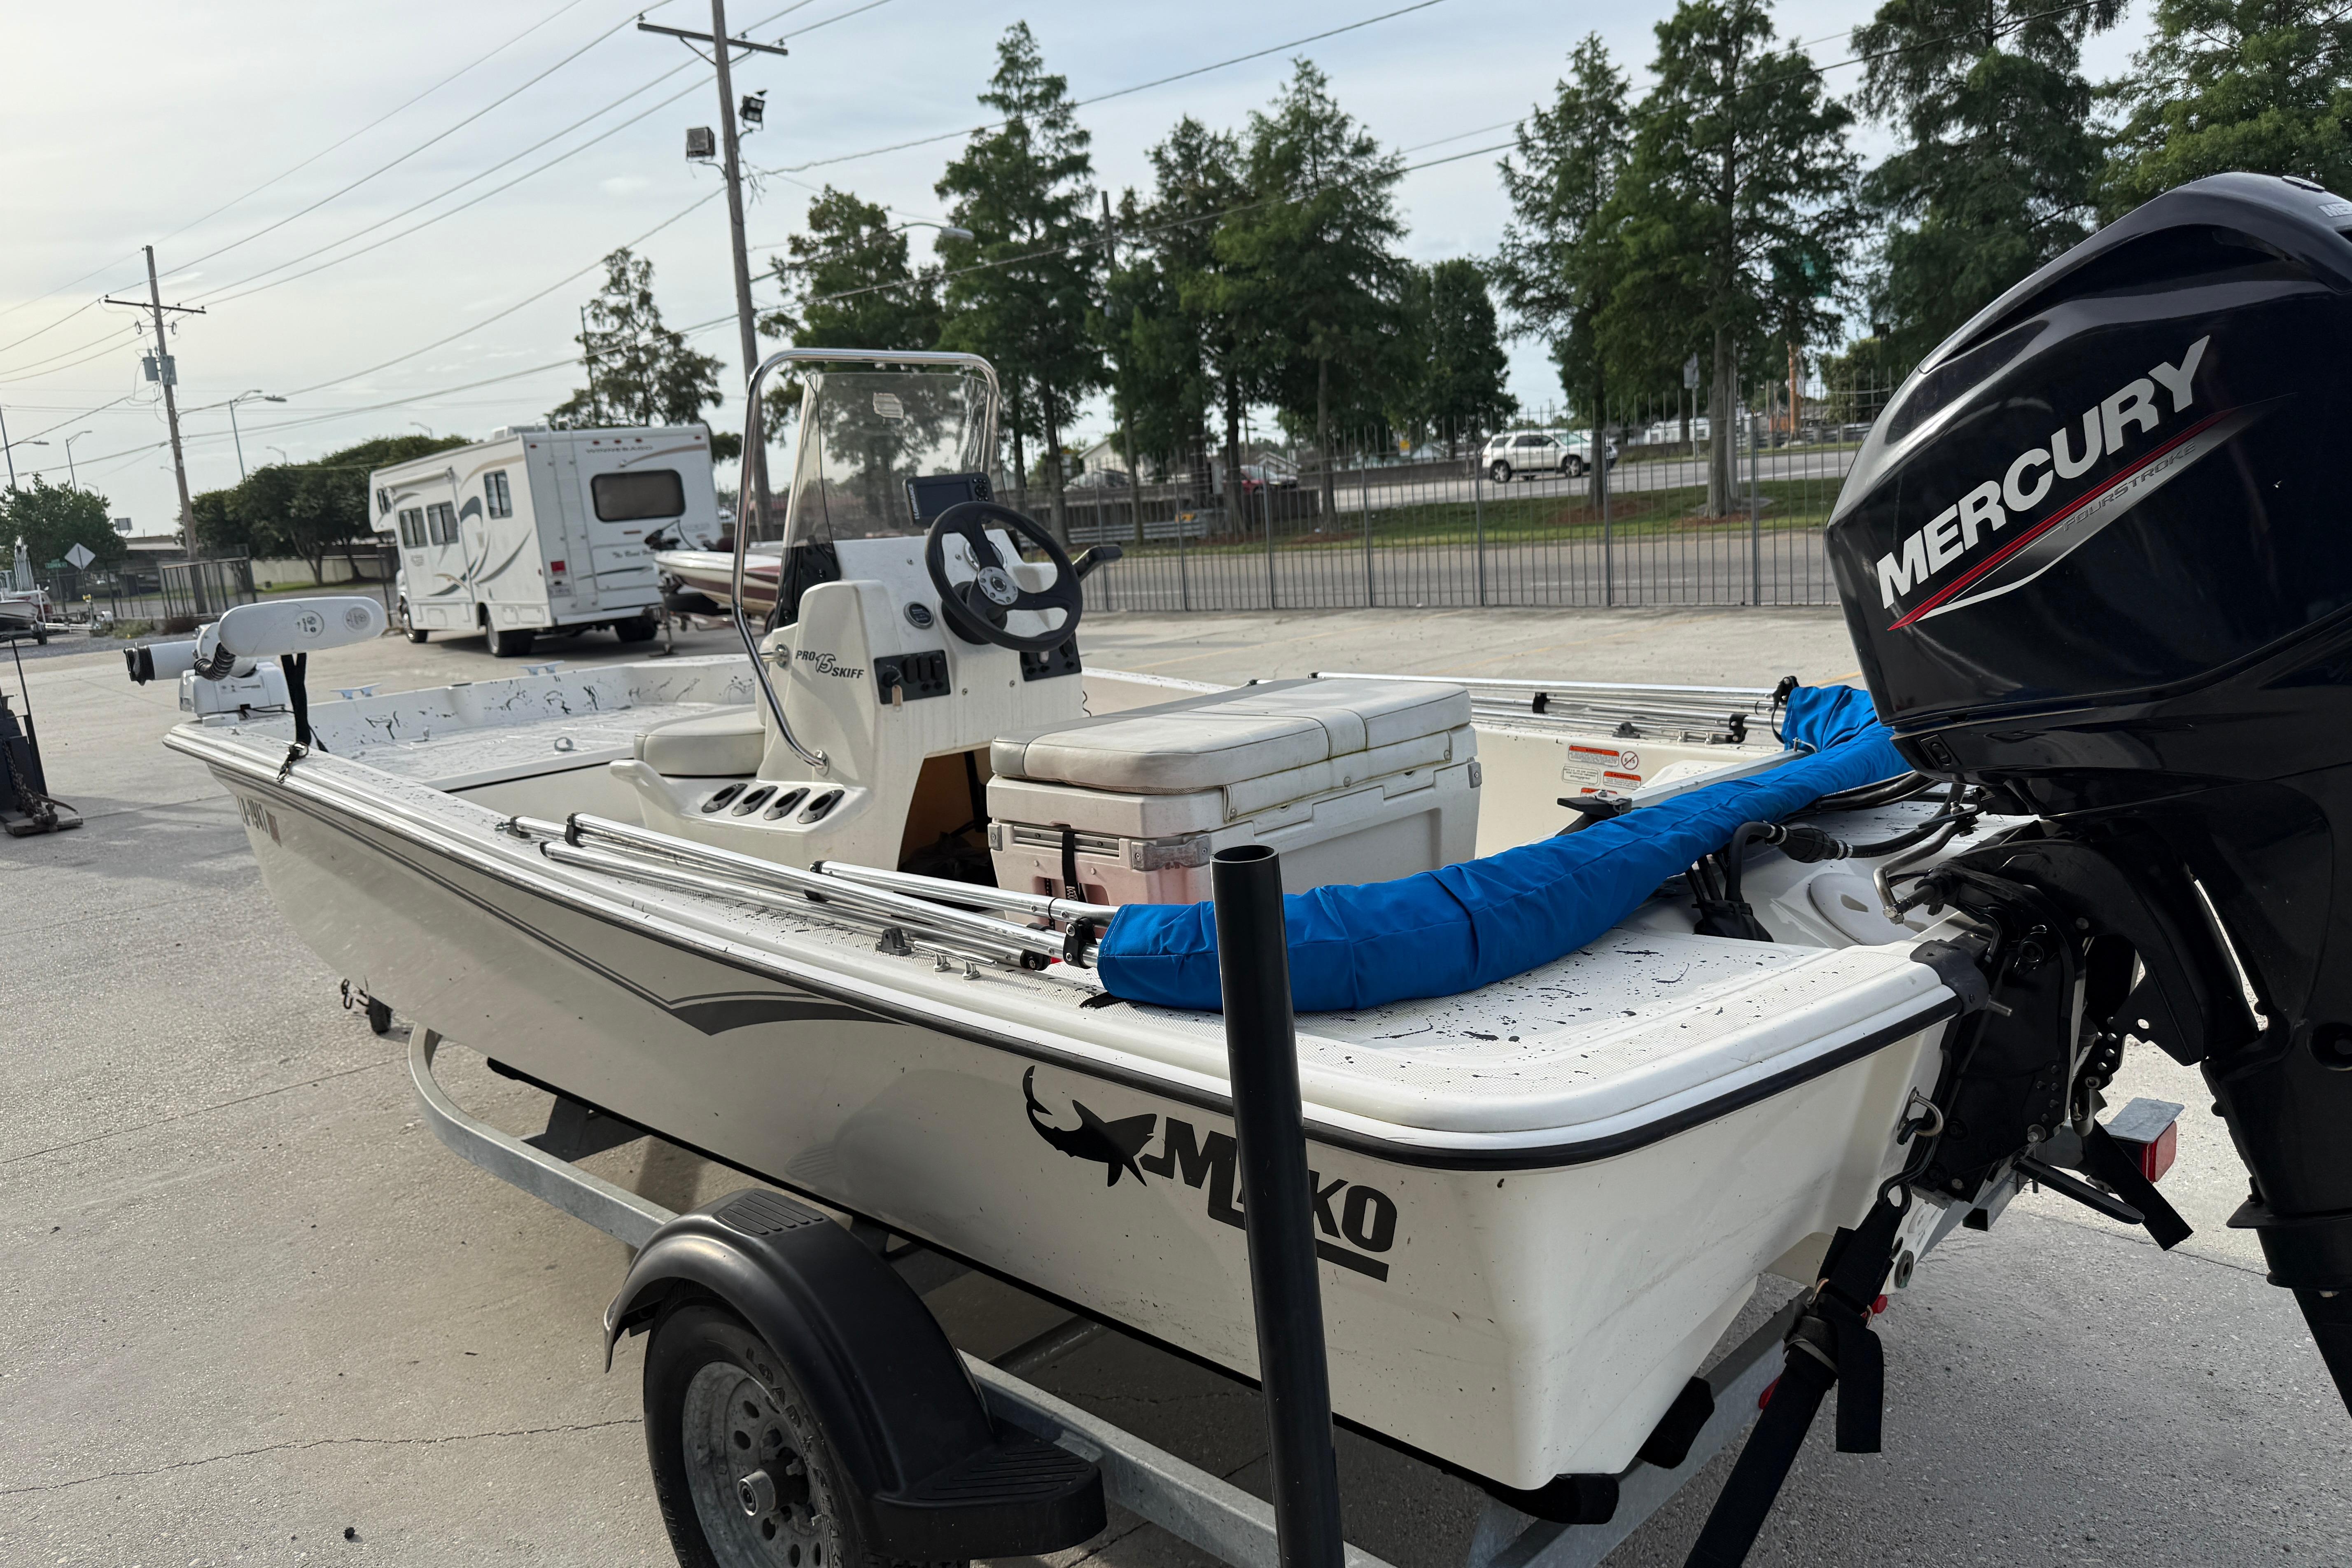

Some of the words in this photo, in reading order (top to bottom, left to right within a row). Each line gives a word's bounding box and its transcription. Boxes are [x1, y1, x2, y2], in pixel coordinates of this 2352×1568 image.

[586, 445, 653, 453] WINNEBAGO
[1876, 334, 2211, 609] MERCURY
[2062, 442, 2196, 532] FOURSTROKE
[907, 483, 919, 516] LOWRANCE
[796, 650, 816, 661] PRO
[815, 653, 836, 674] 15
[831, 667, 864, 679] SKIFF
[1139, 1116, 1397, 1282] MKO
[746, 1346, 801, 1428] LOAD
